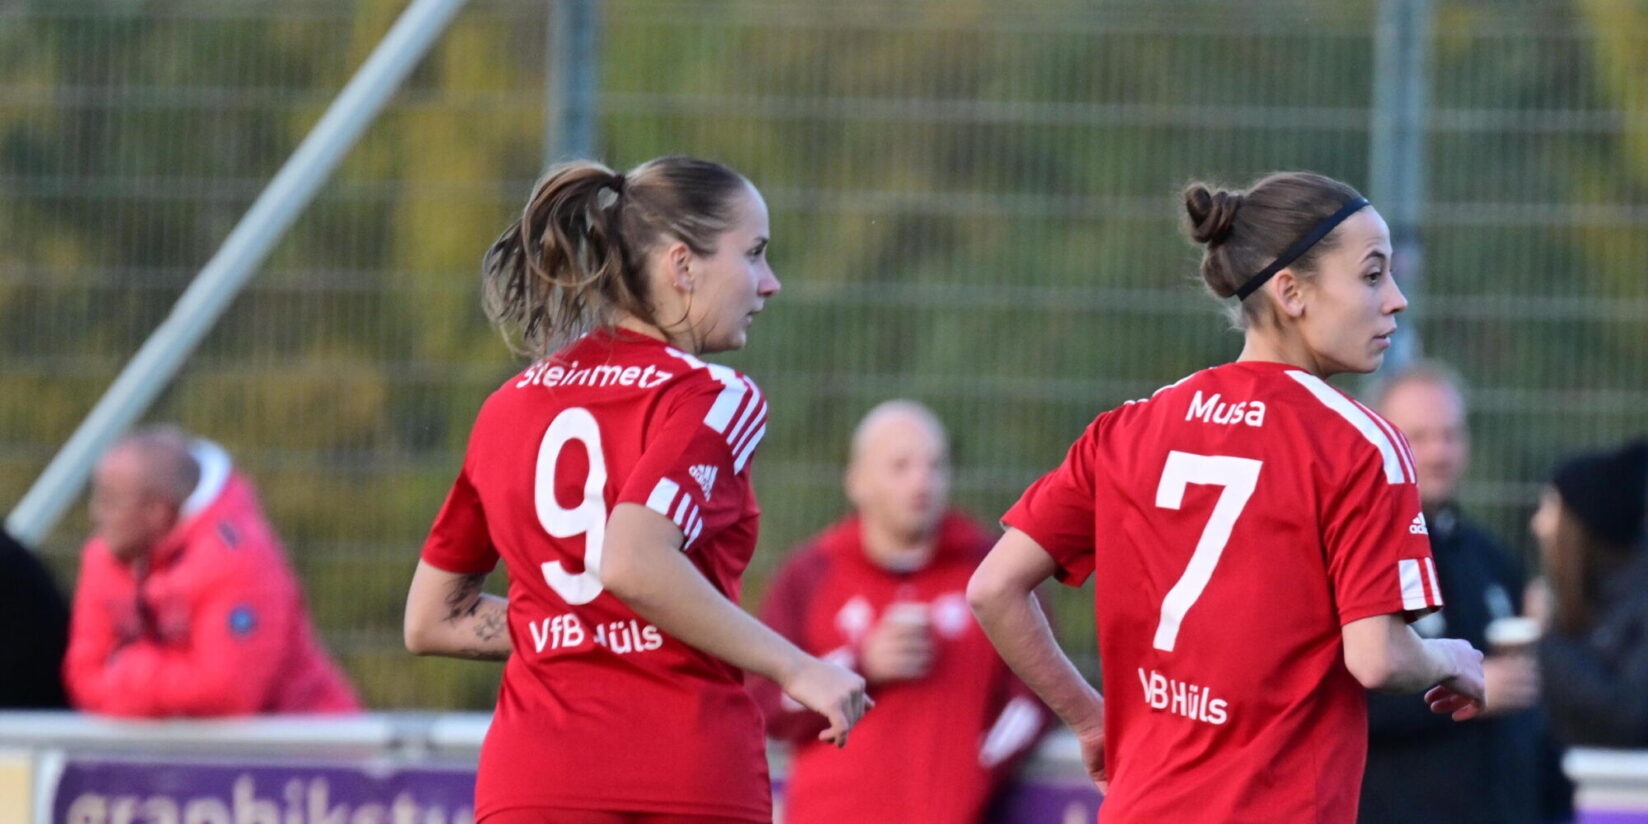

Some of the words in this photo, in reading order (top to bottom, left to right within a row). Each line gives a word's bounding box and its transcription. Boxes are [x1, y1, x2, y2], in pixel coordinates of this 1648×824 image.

[516, 360, 673, 388] Steinmetz
[1185, 390, 1266, 427] Musa
[534, 407, 607, 605] 9
[1153, 450, 1264, 652] 7
[529, 613, 585, 653] VfB
[1170, 679, 1228, 725] Hüls
